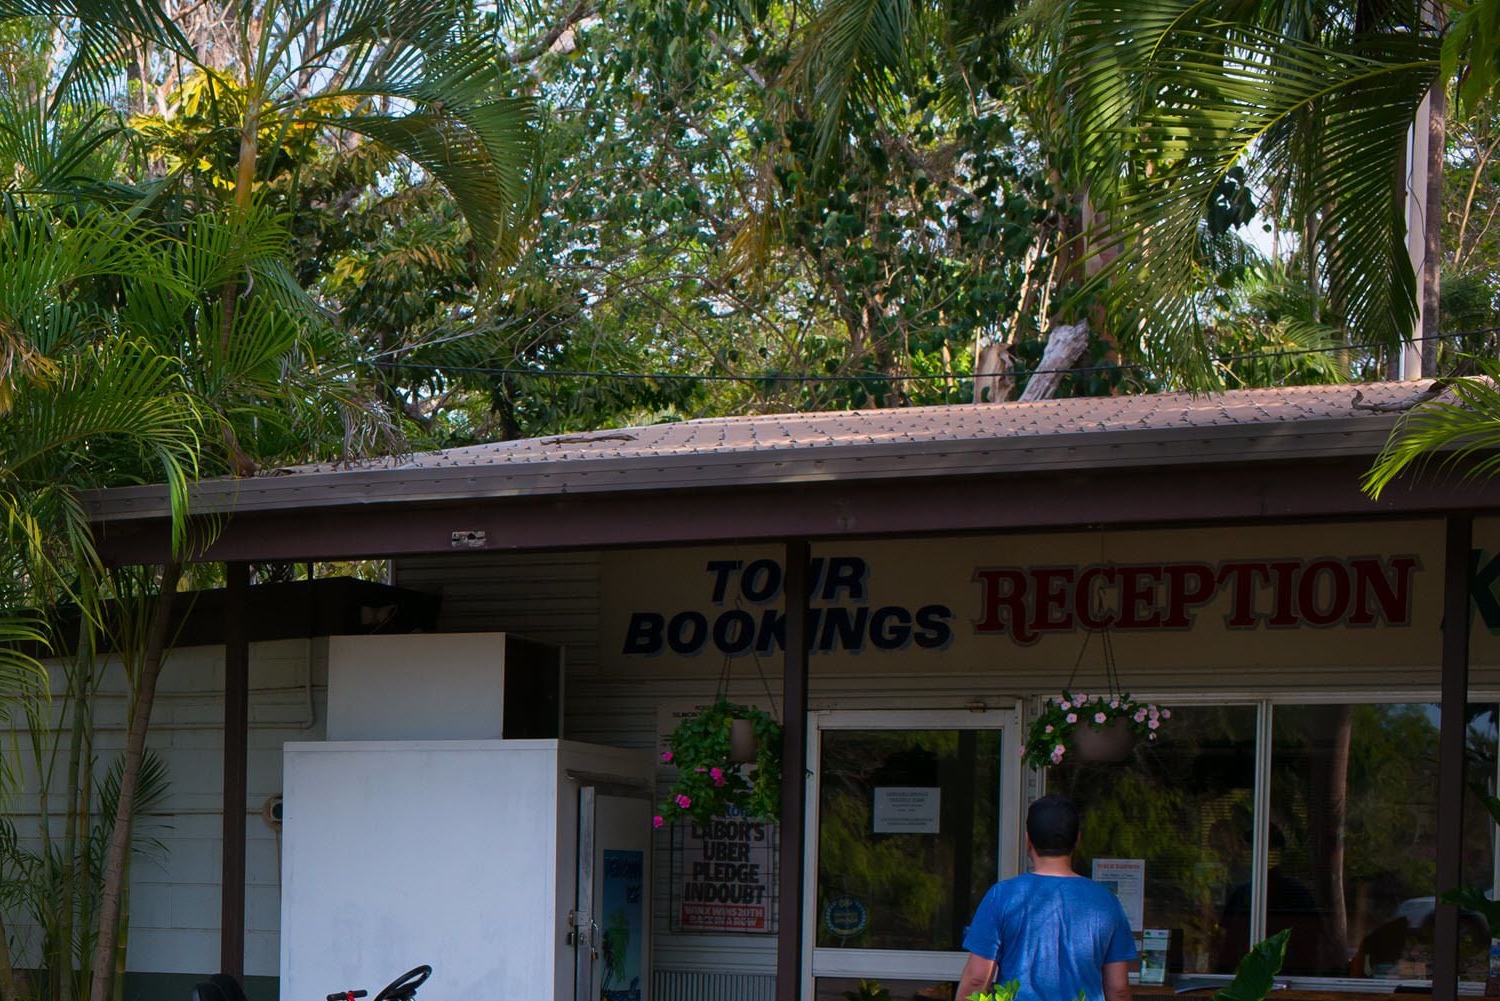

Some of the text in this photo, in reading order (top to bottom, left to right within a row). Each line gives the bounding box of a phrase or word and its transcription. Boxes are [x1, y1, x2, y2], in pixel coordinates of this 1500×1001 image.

[974, 557, 1420, 645] RECEPTION
[703, 841, 750, 862] UBER
[693, 862, 760, 883] PLEDGE
